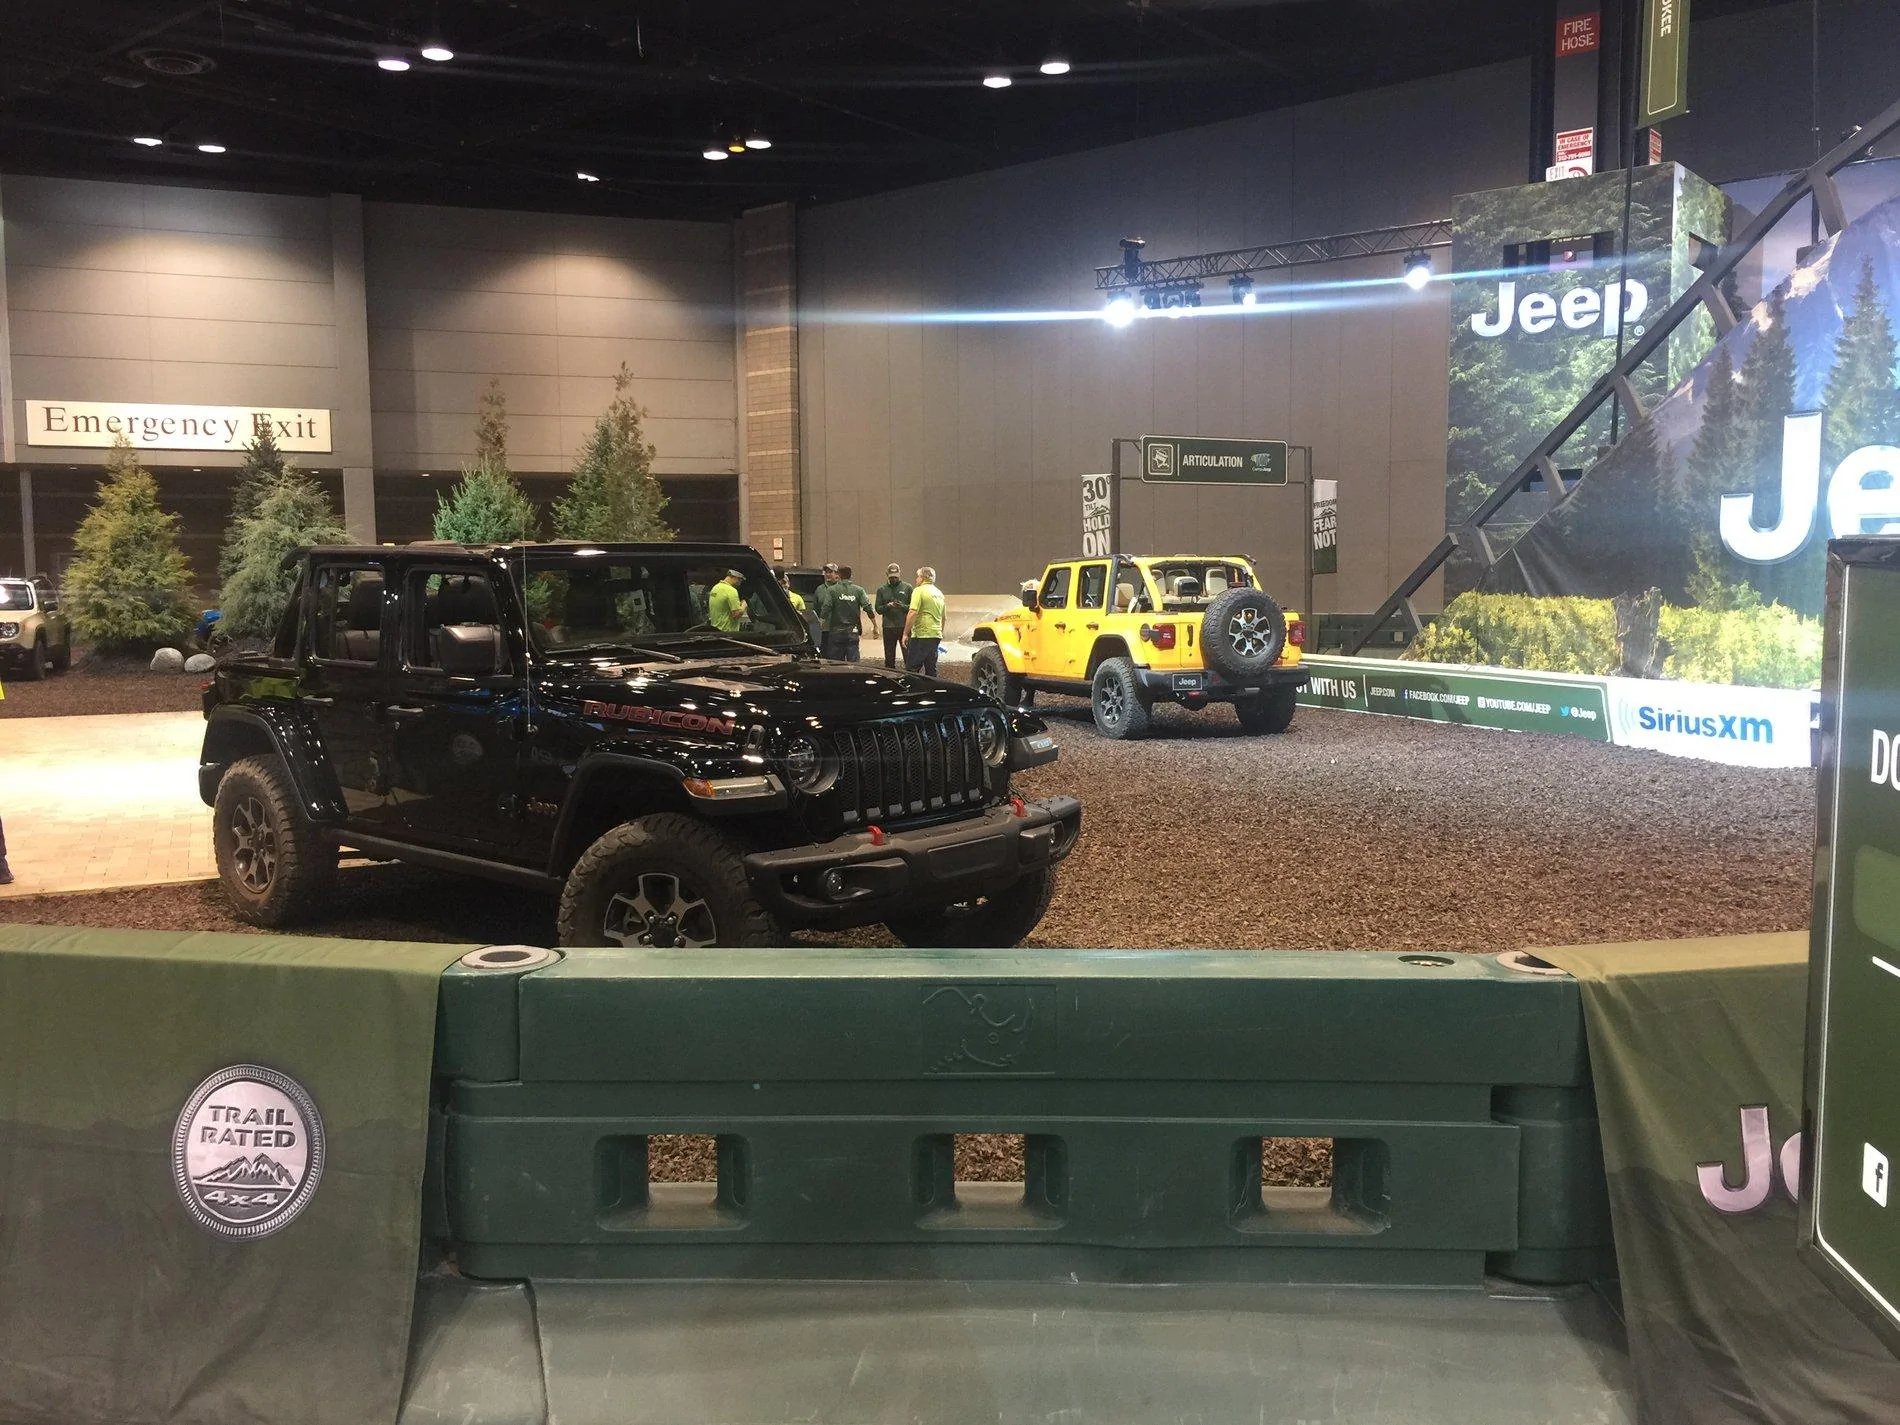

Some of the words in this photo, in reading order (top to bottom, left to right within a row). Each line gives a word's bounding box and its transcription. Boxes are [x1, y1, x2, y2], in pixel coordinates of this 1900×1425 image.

[1563, 18, 1592, 36] FIRE
[1561, 33, 1595, 51] HOSE
[1558, 140, 1591, 151] EMERGENCY
[1550, 166, 1565, 180] EXIT
[1471, 279, 1648, 337] Jeep
[43, 406, 239, 443] Emergency
[252, 411, 317, 439] Exit
[1182, 454, 1243, 468] ARTICULATION
[1083, 514, 1111, 533] HOLD
[1313, 516, 1337, 533] FEAR
[1083, 529, 1111, 558] ON
[1313, 529, 1337, 551] NOT
[839, 593, 857, 602] Jeep
[1178, 677, 1197, 687] Jeep
[1310, 677, 1339, 697] WITH
[1341, 680, 1357, 700] US
[1370, 686, 1396, 698] JEEP.COM
[1485, 698, 1551, 715] YOUTUBE.COM/JEEP
[1570, 707, 1597, 722] @Jeep
[583, 700, 736, 736] RUBICON
[208, 1105, 294, 1127] TRAIL
[200, 1126, 297, 1149] RATED
